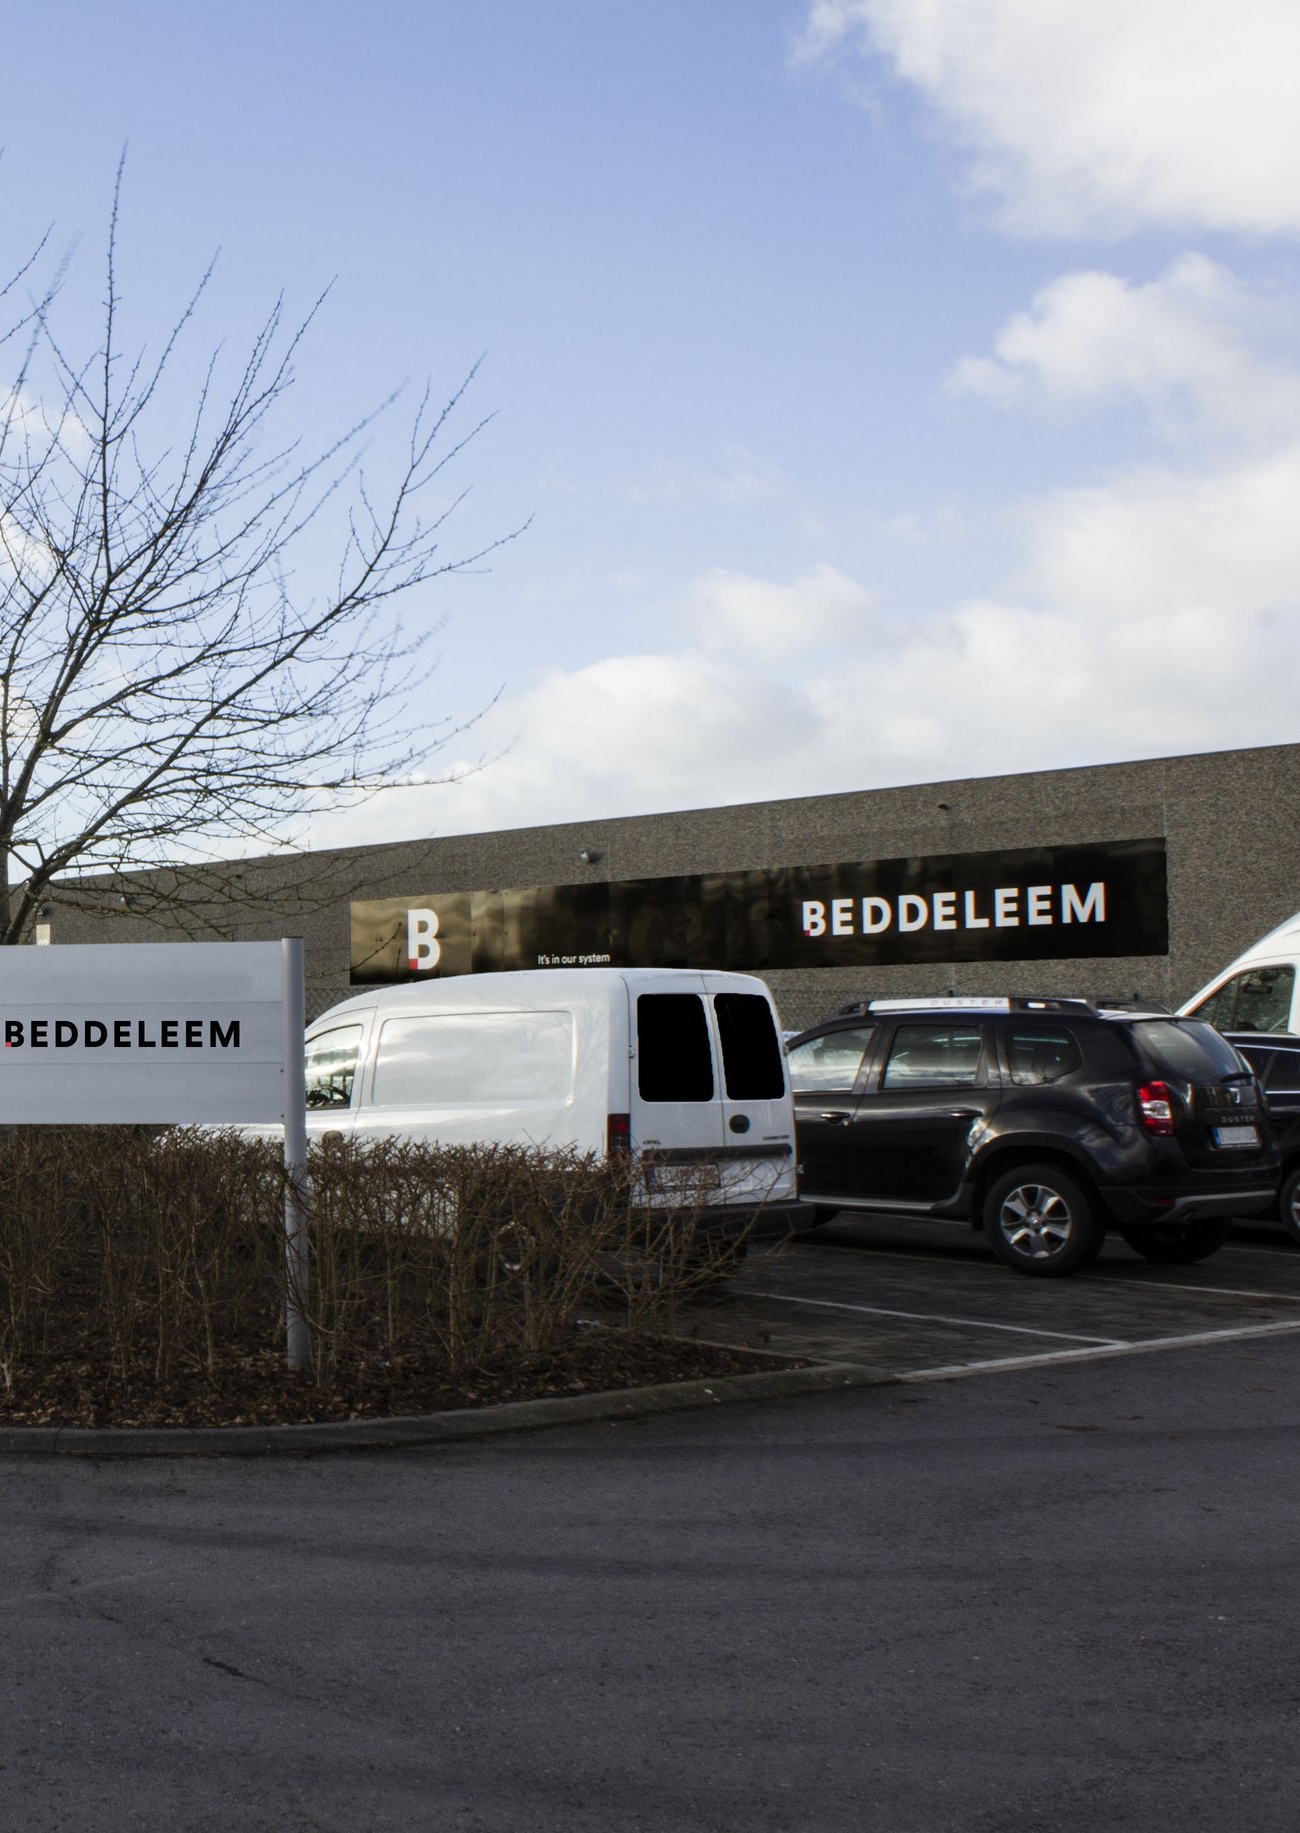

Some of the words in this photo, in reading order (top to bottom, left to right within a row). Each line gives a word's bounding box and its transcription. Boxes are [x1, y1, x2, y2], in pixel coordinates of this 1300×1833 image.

[802, 882, 1107, 938] BEDDELEEM
[407, 908, 441, 970] B
[537, 954, 550, 965] It's
[551, 953, 560, 965] in
[561, 955, 577, 964] our
[578, 953, 611, 966] system
[5, 1020, 241, 1048] BEDDELEEM
[1221, 1115, 1255, 1123] DUSTER
